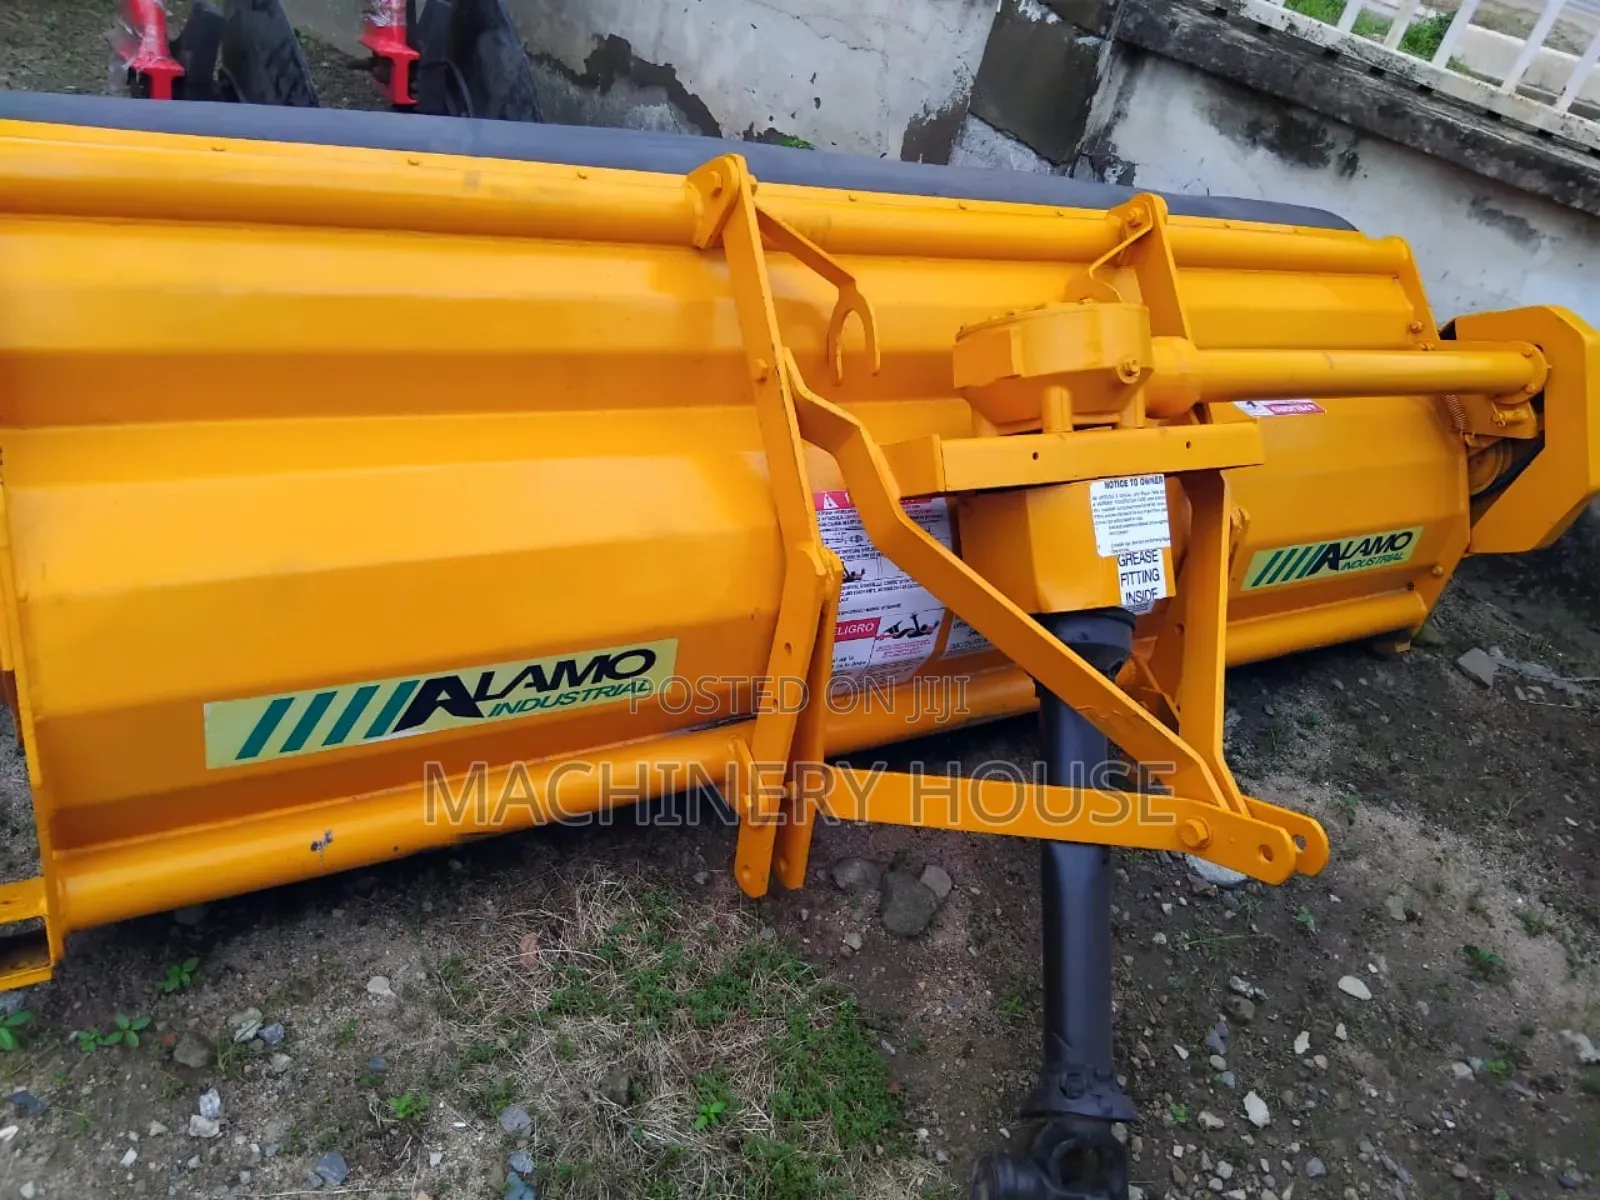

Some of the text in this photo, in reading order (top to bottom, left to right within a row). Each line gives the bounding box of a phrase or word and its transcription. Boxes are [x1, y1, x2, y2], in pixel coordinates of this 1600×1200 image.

[1104, 475, 1164, 489] NOTICE TO OWNER
[1117, 549, 1160, 567] GREASE
[1307, 531, 1413, 577] ALAMO
[1340, 552, 1405, 571] INDUSTRIAL
[1120, 568, 1160, 587] FITTING
[1125, 587, 1159, 605] INSIDE
[834, 622, 875, 637] LIGRO
[391, 648, 657, 733] ALAMO
[487, 678, 654, 718] INDUSTRIAL
